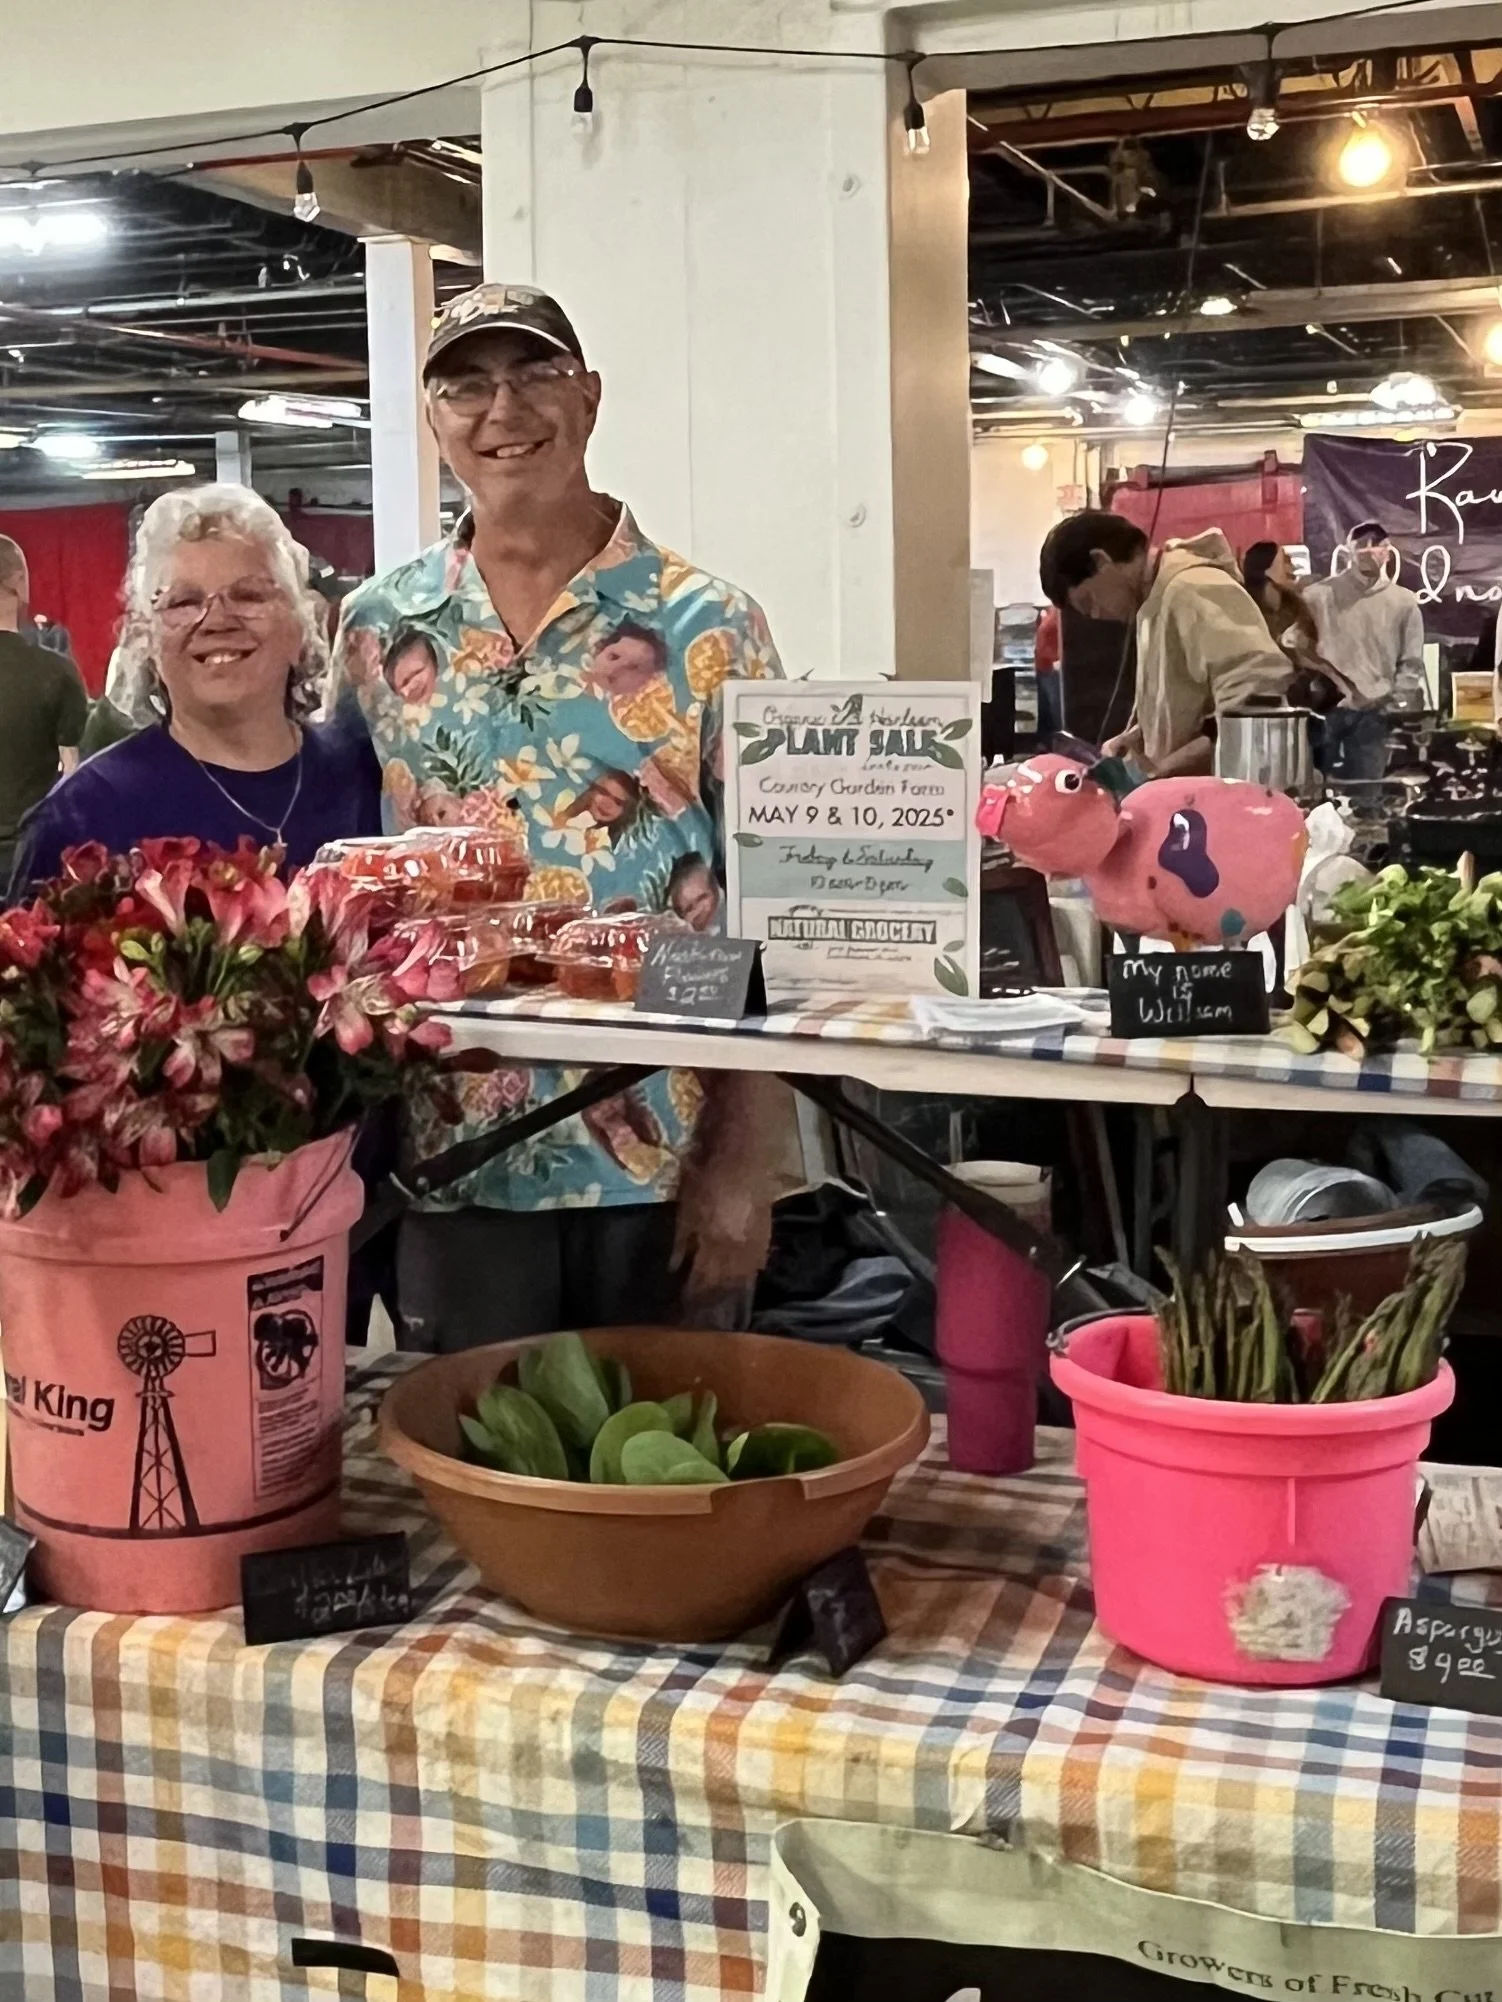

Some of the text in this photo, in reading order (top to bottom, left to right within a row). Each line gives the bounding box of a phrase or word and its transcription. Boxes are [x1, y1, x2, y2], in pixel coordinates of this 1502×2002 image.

[766, 727, 938, 757] PLANT SALE
[749, 804, 799, 824] MAY
[806, 805, 819, 825] 9
[828, 806, 842, 826] &
[853, 806, 884, 830] 10,
[769, 918, 848, 941] NATURAL
[1176, 961, 1232, 982] name
[1139, 998, 1232, 1023] William
[1138, 1940, 1273, 1988] Growers
[1285, 1974, 1322, 1994] of
[1332, 1975, 1422, 2002] Fresh
